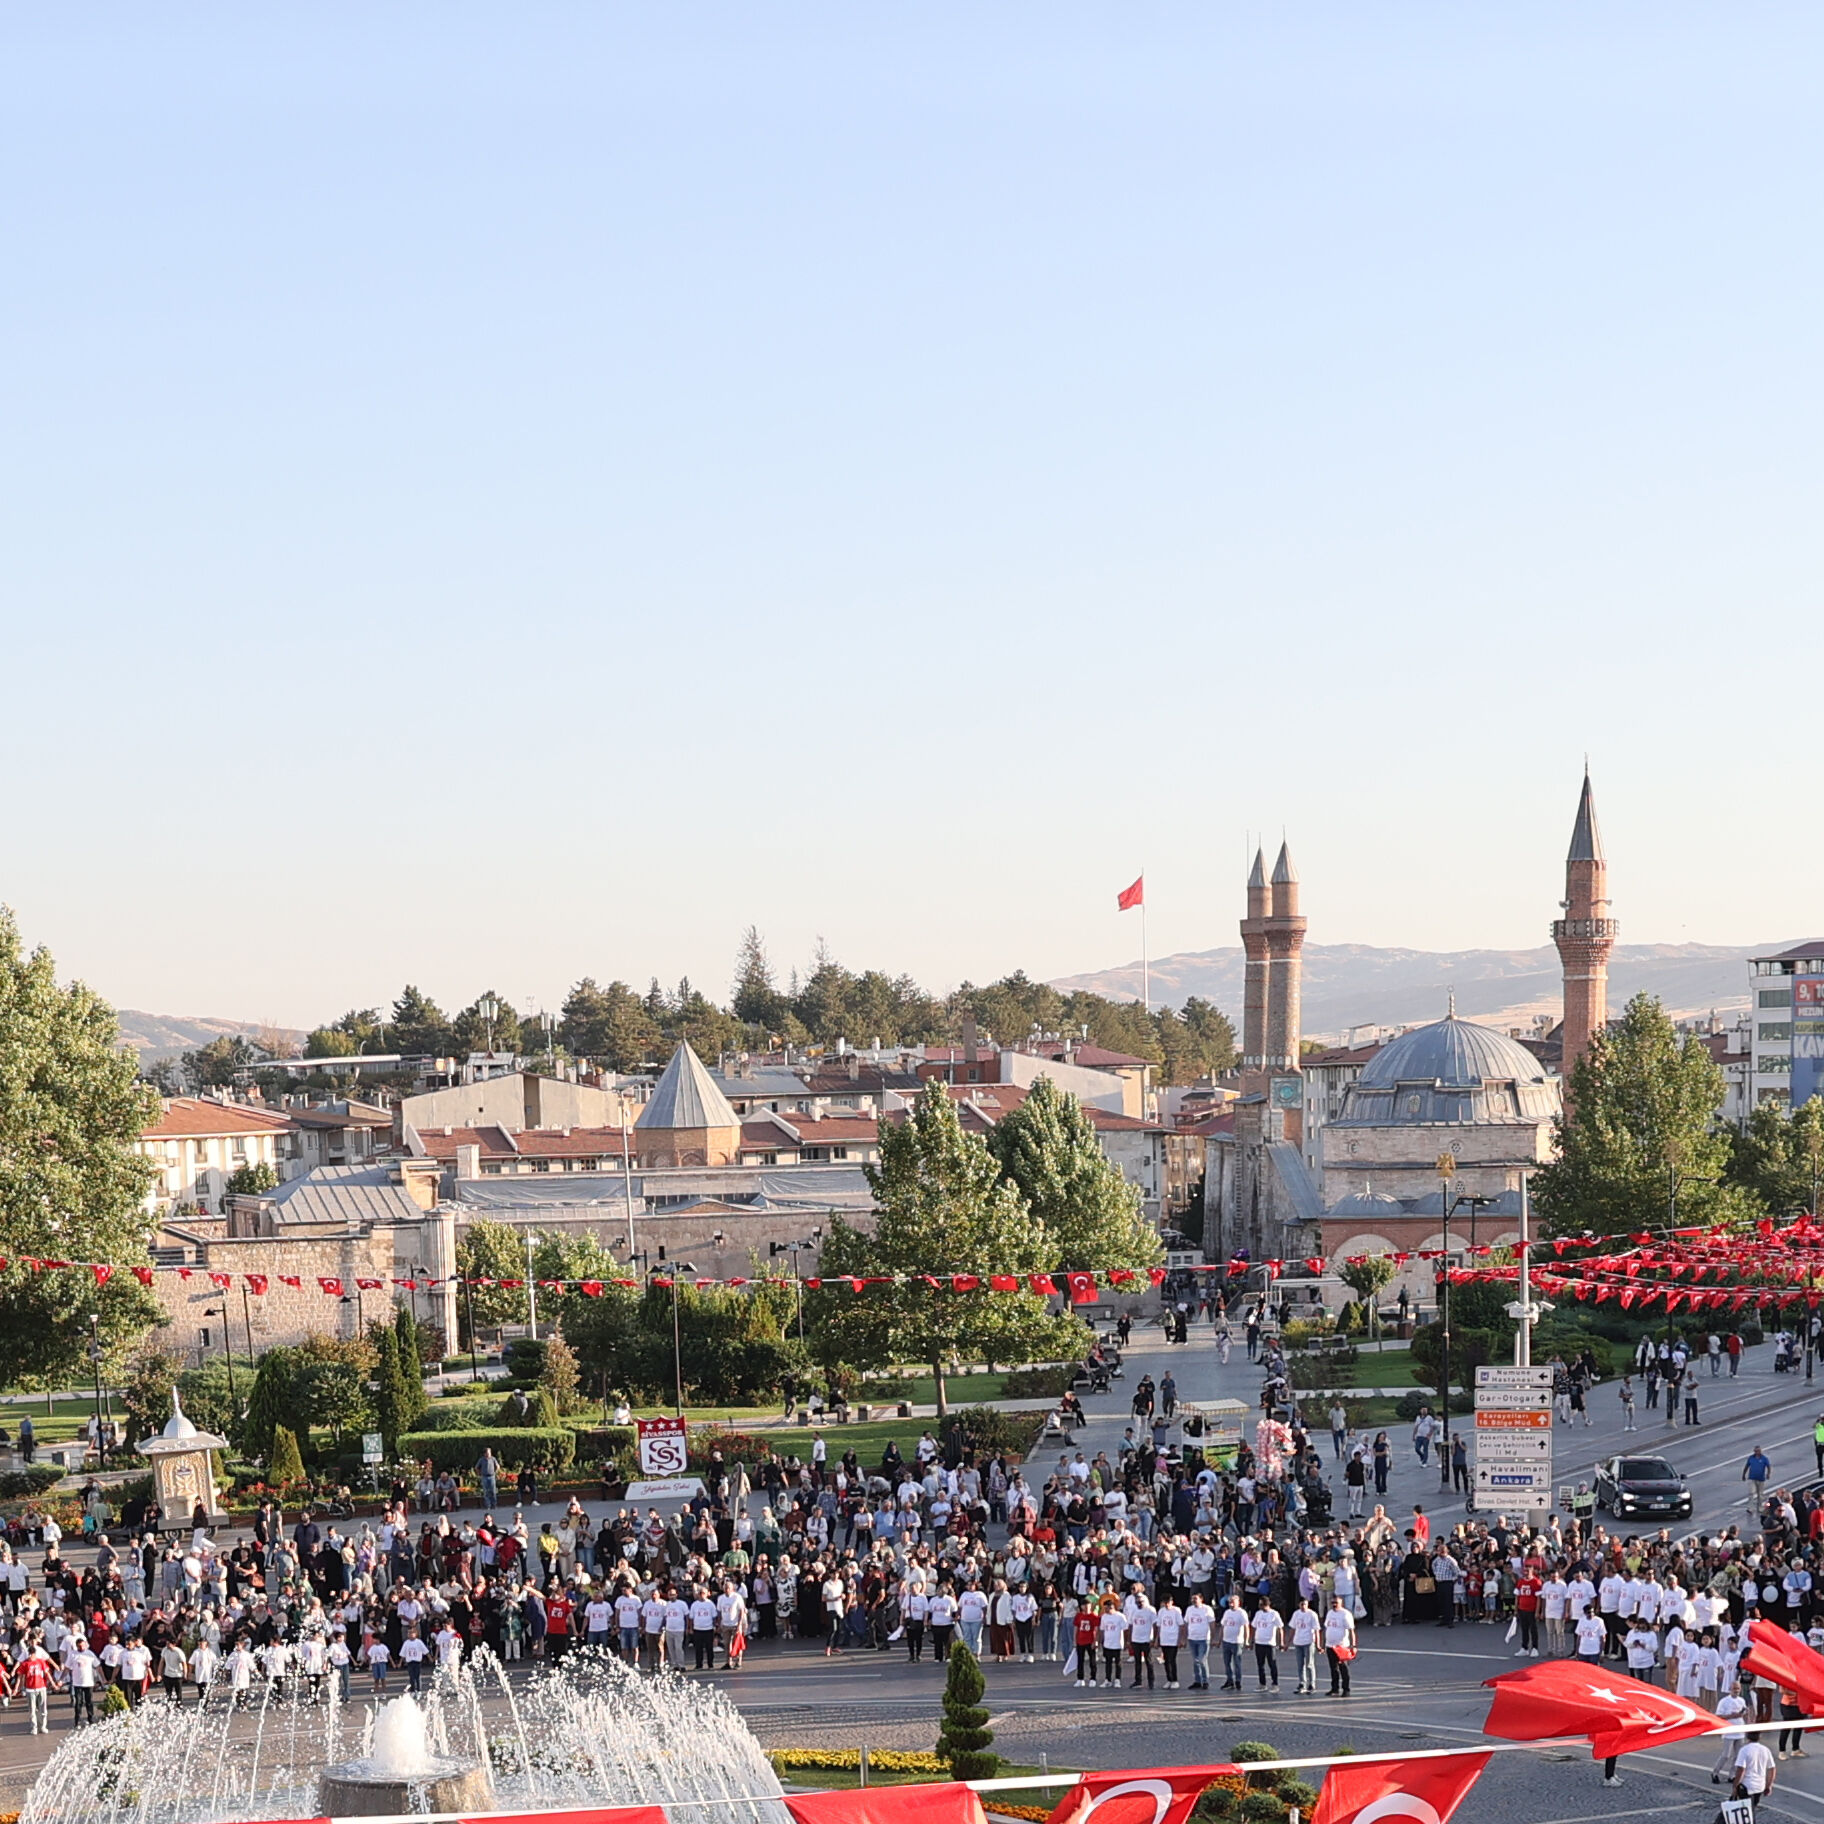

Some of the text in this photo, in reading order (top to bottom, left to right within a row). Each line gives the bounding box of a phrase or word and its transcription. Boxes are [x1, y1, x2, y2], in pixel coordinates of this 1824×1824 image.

[1798, 1007, 1824, 1016] MEZUN
[1479, 1394, 1535, 1403] Gar-Otogar
[641, 1429, 684, 1439] SİVASSPOR
[1491, 1465, 1548, 1473] Havalimanı
[1493, 1476, 1531, 1485] Ankara
